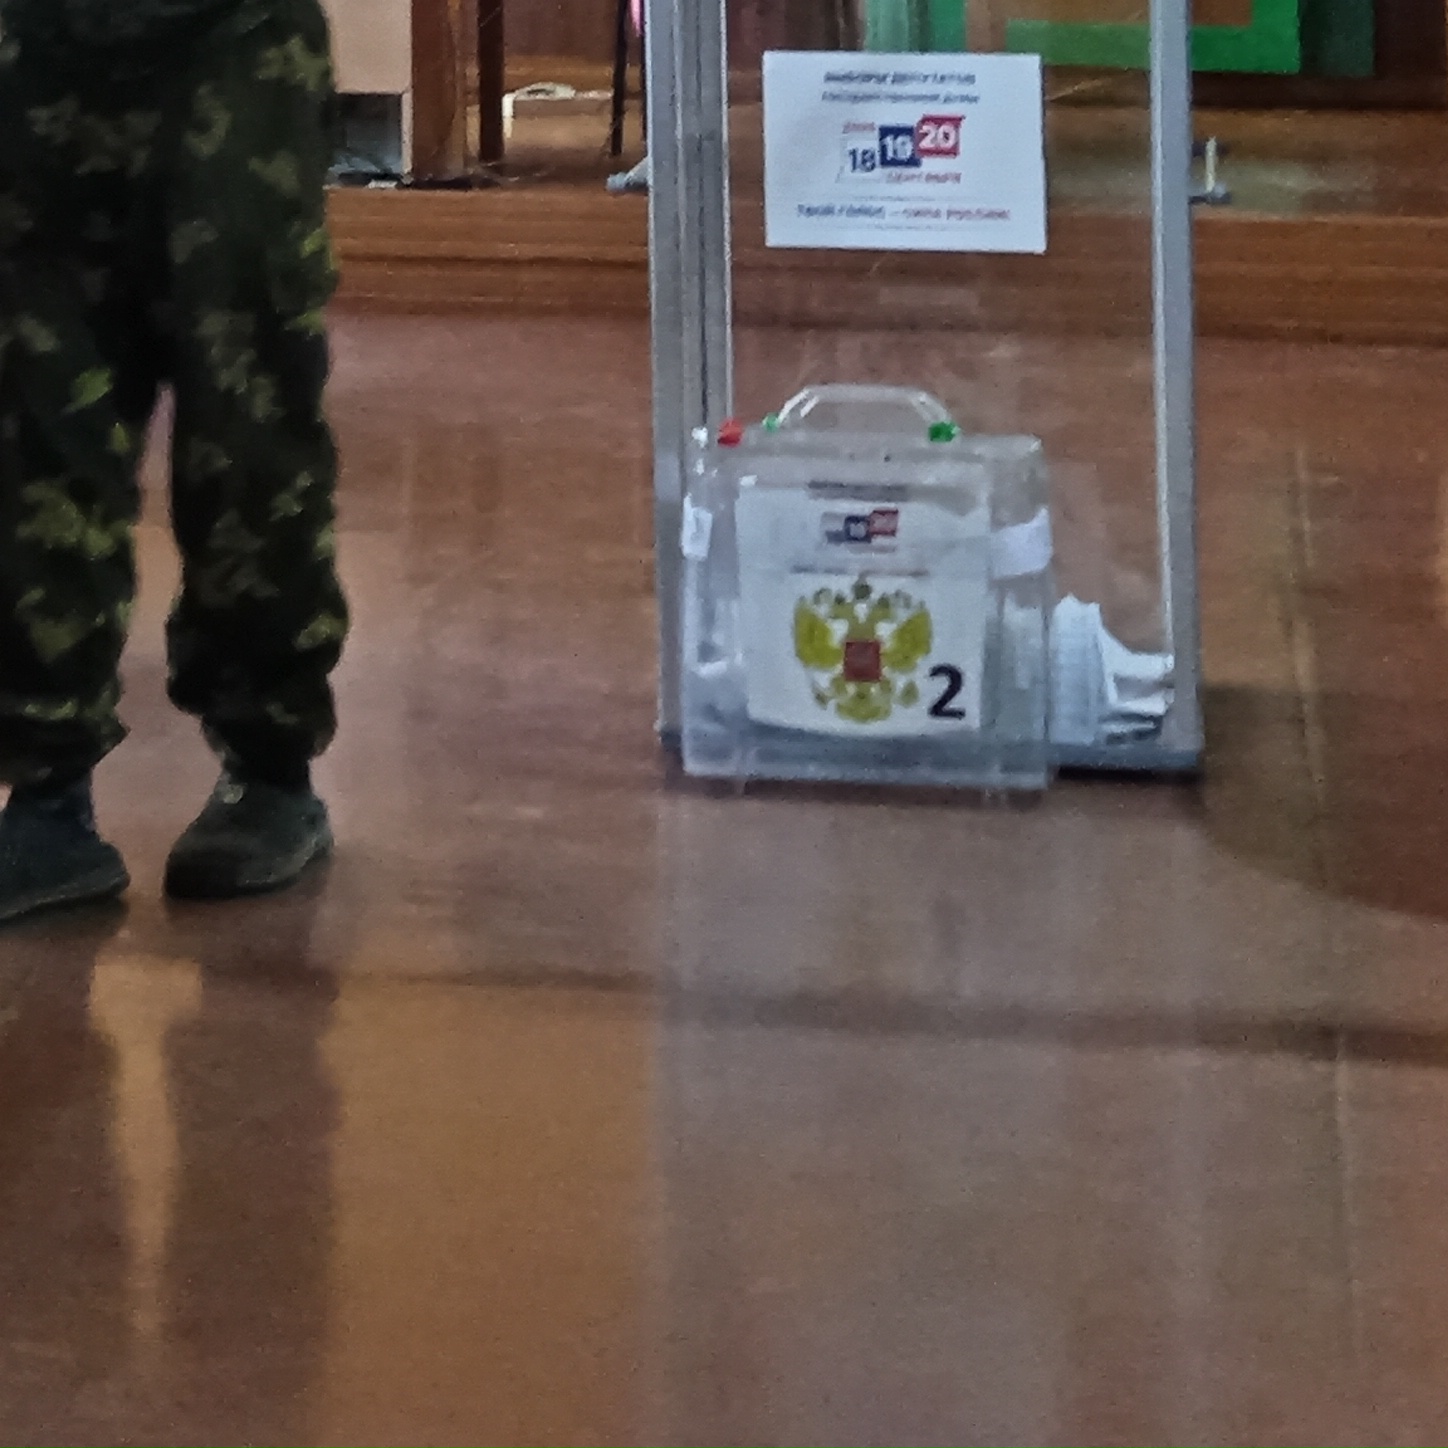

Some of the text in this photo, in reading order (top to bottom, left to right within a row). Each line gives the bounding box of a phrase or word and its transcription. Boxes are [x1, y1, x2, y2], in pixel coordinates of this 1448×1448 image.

[847, 124, 957, 172] 18 19 20
[927, 665, 966, 720] 2
